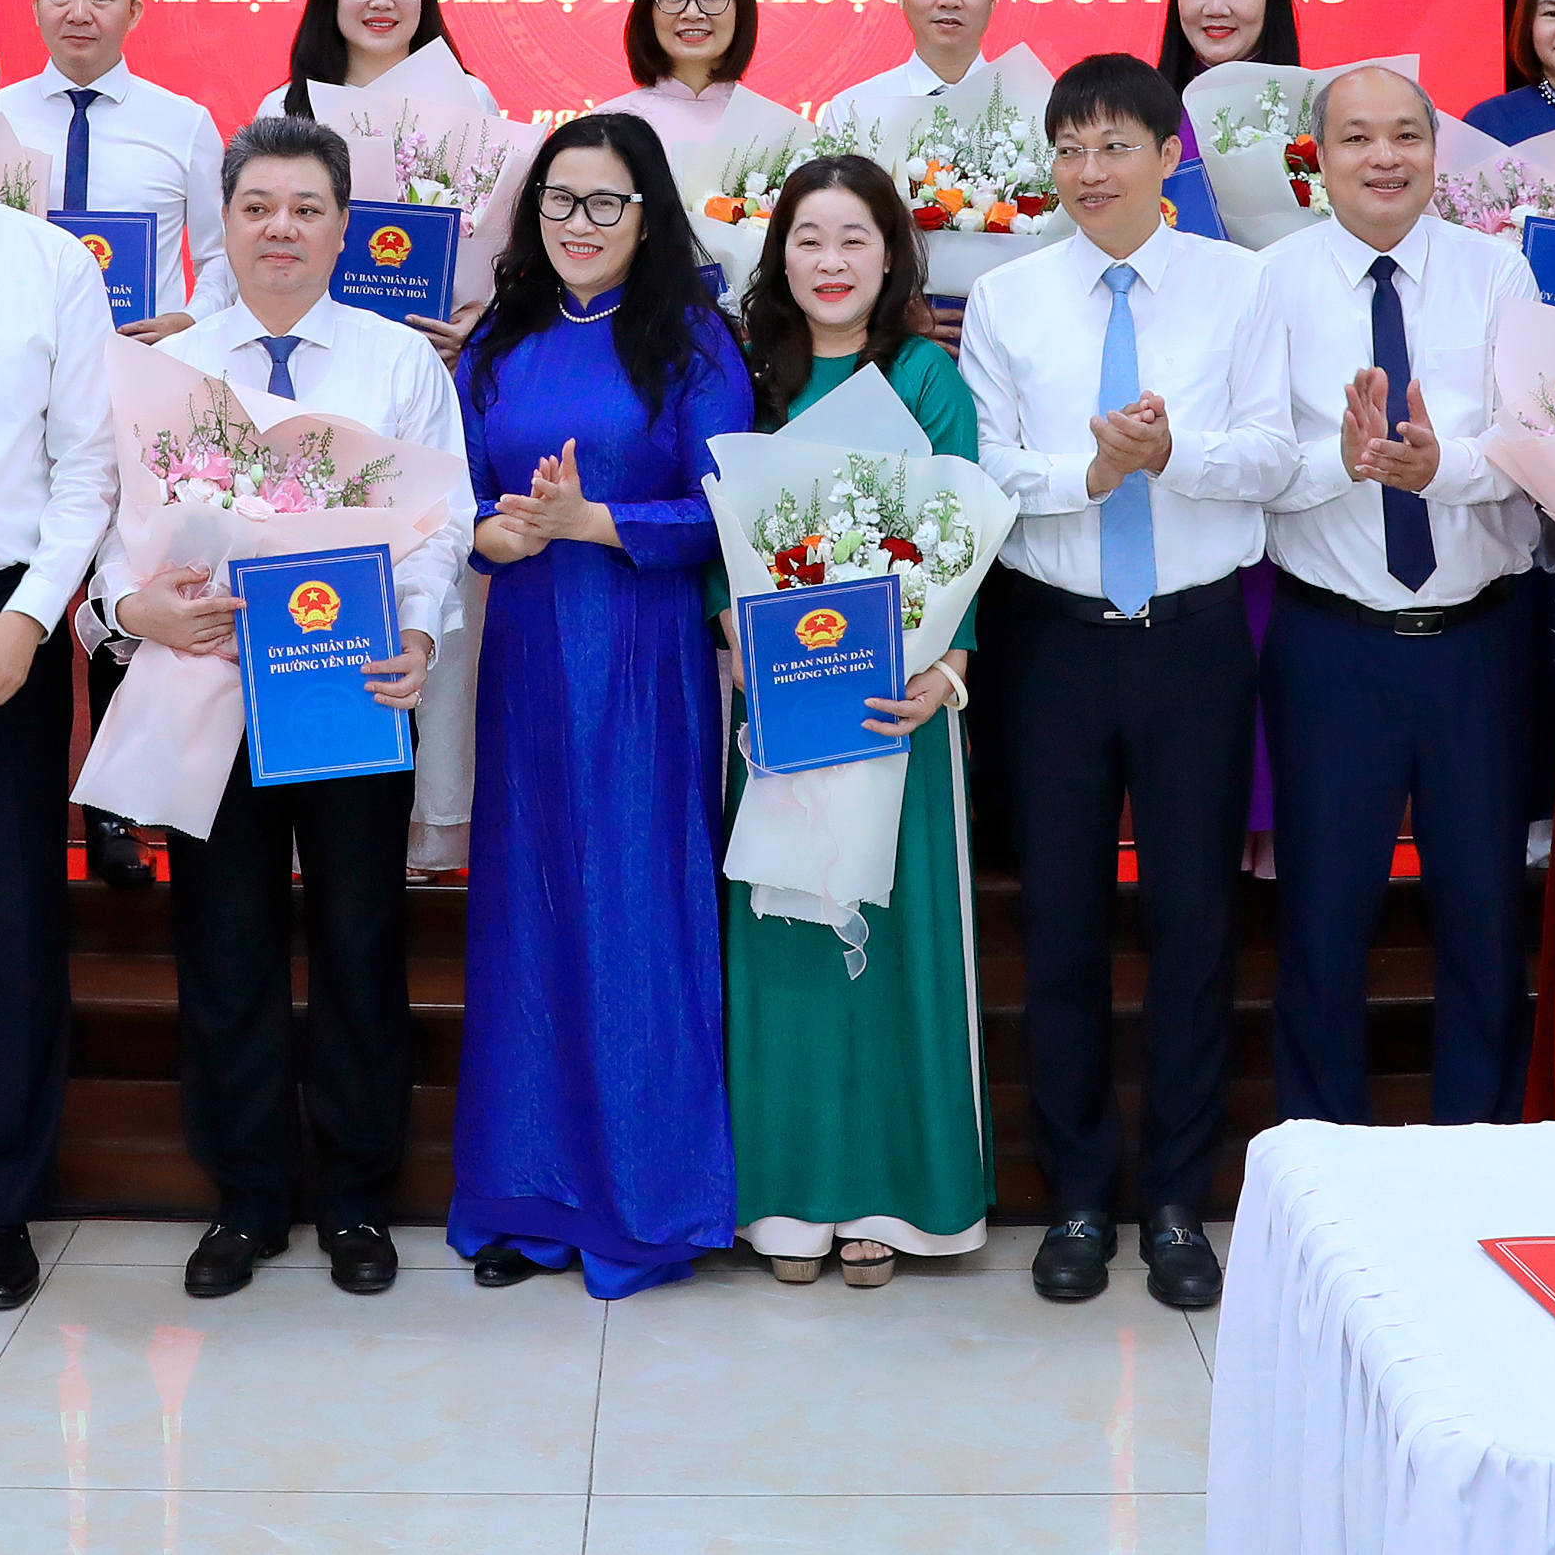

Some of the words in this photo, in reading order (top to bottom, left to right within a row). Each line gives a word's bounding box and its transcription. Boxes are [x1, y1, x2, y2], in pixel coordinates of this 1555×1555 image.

[344, 271, 357, 281] ỦY
[359, 274, 378, 282] BAN
[380, 274, 407, 284] NHÂN
[409, 276, 429, 286] DÂN
[113, 284, 132, 294] DÂN
[343, 284, 384, 295] PHƯỜNG
[386, 286, 405, 297] YÊN
[406, 289, 427, 298] HOÀ
[112, 297, 132, 307] HOÀ
[268, 646, 284, 658] ỦY
[286, 645, 309, 656] BAN
[311, 639, 344, 653] NHÂN
[346, 636, 370, 649] DÂN
[270, 659, 319, 674] PHƯỜNG
[321, 655, 344, 668] YÊN
[346, 651, 372, 665] HOÀ
[773, 663, 788, 672] ỦY
[791, 659, 813, 670] BAN
[816, 653, 848, 665] NHÂN
[850, 649, 874, 660] DÂN
[774, 670, 822, 684] PHƯỜNG
[824, 664, 847, 676] YÊN
[849, 659, 874, 671] HOÀ
